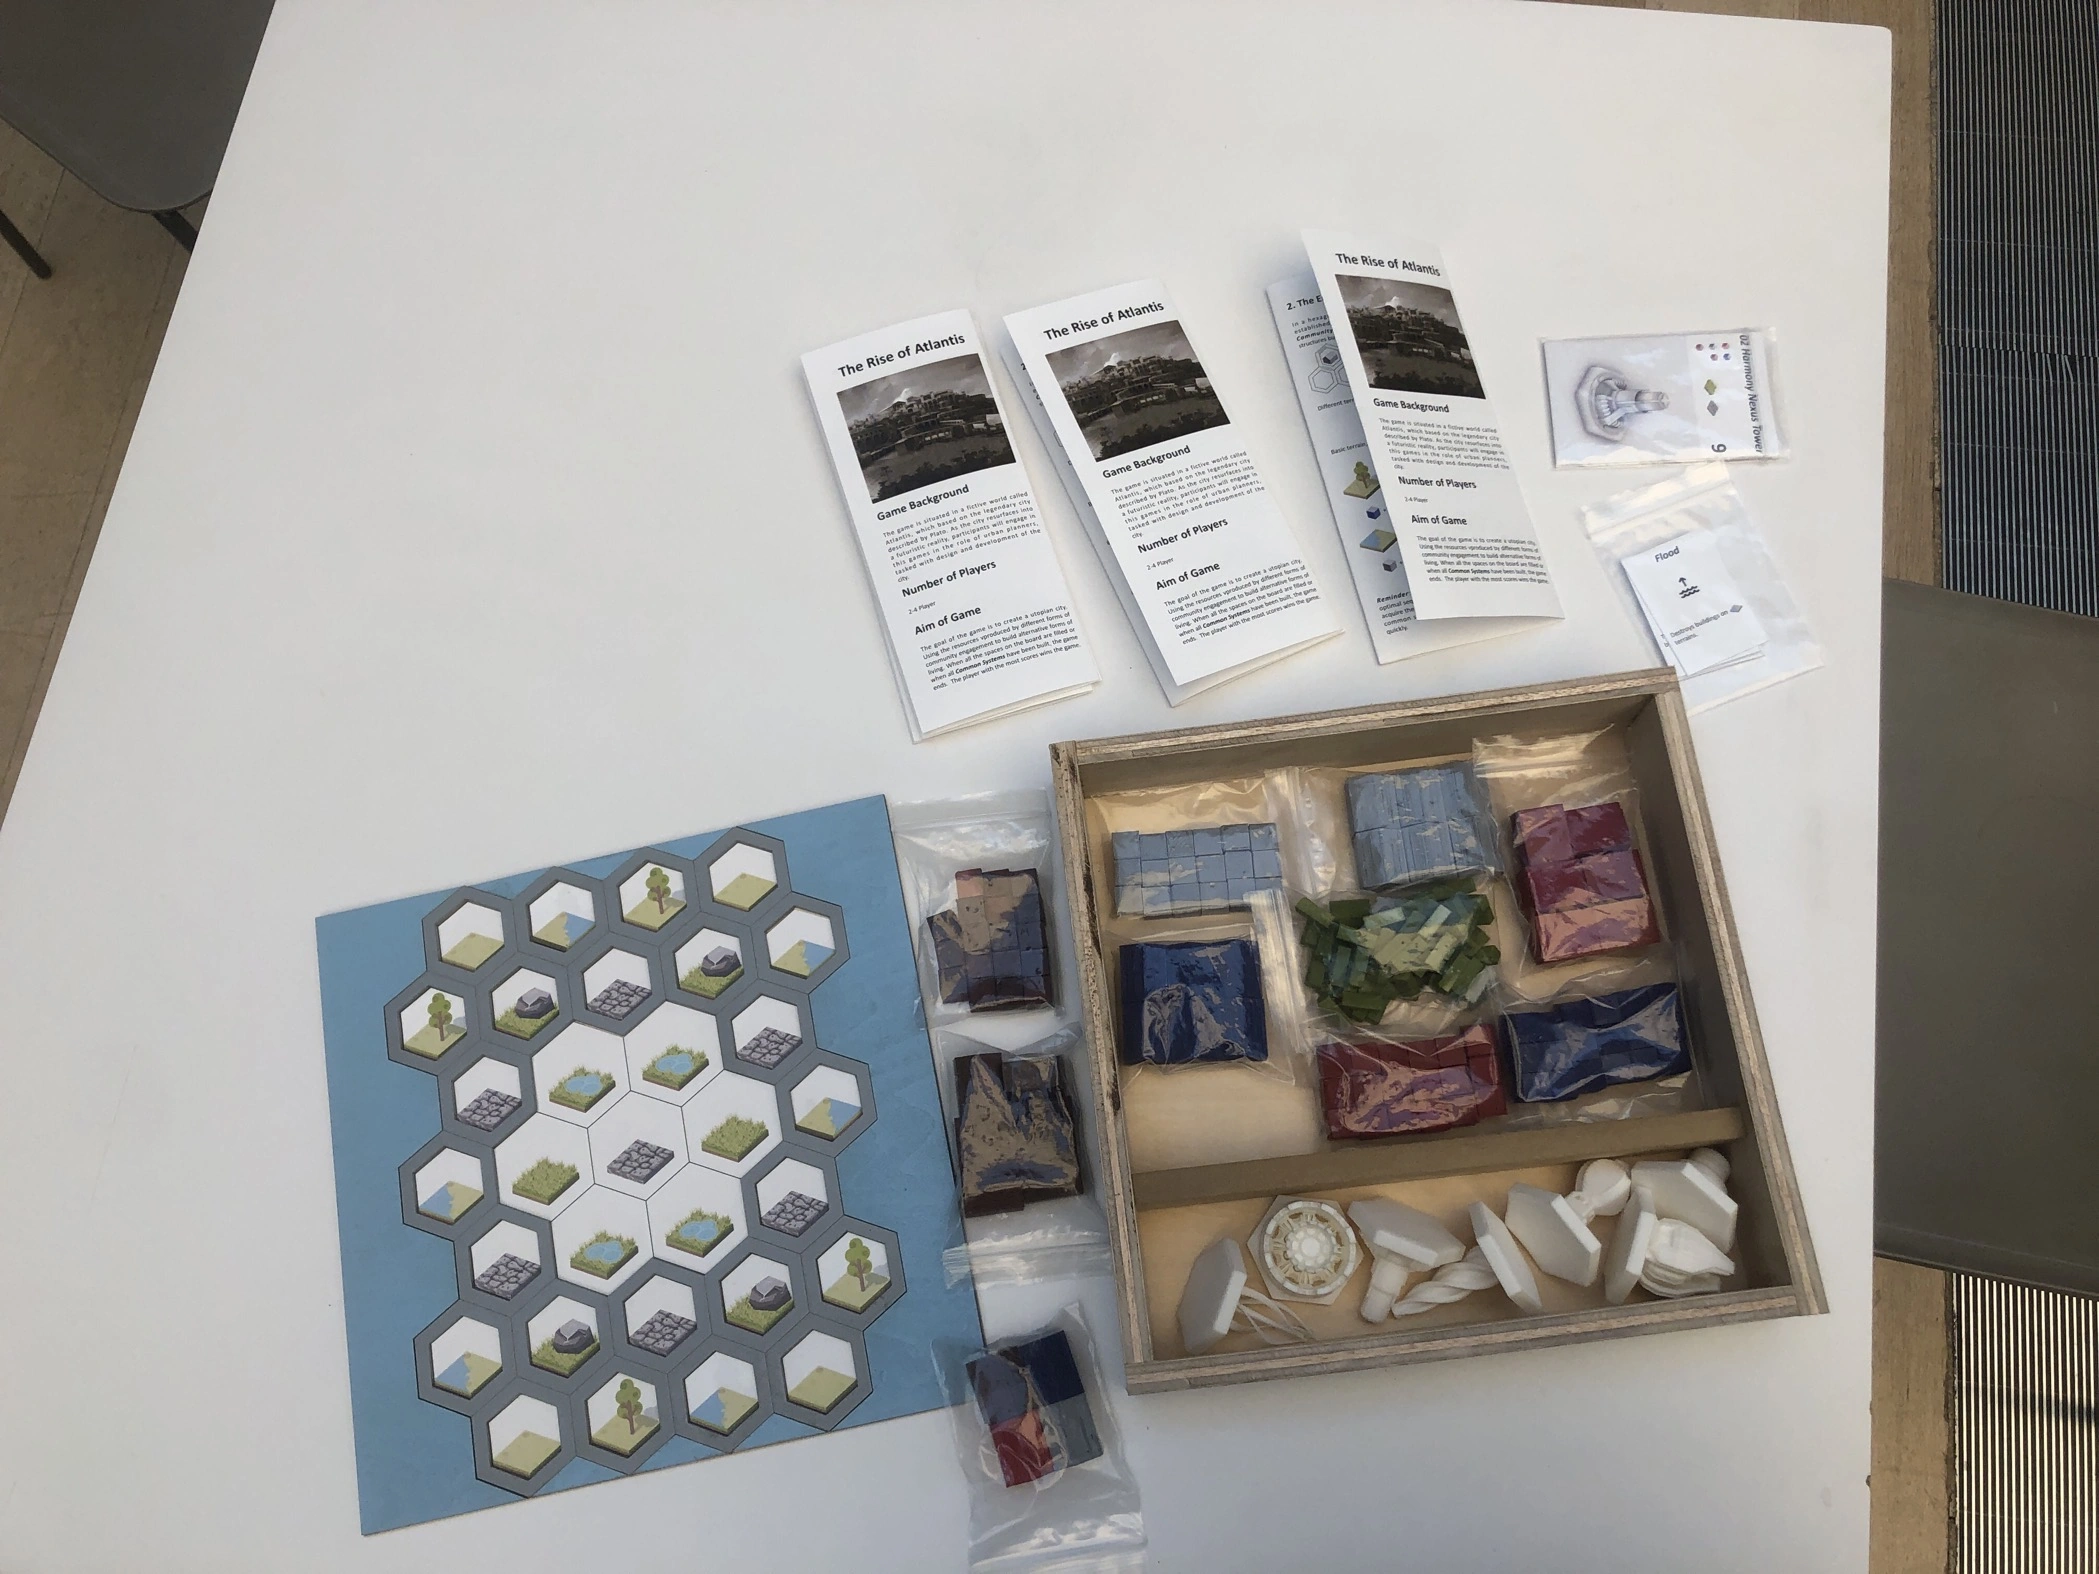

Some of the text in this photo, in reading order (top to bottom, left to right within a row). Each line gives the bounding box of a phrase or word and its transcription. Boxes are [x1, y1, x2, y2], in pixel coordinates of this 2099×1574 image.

[1335, 253, 1441, 277] The Rise of Atlantis
[1286, 302, 1296, 310] 2.
[1296, 298, 1315, 307] The
[1043, 301, 1164, 340] The Rise of Atlantis
[1294, 321, 1331, 334] established
[1296, 328, 1333, 341] Community
[837, 334, 965, 377] The Rise of Atlantis
[1298, 338, 1327, 348] structures
[1317, 400, 1342, 411] Different
[1373, 398, 1450, 413] Game Background
[1739, 333, 1763, 453] 02 Harmony Nexus Tower
[1102, 445, 1191, 478] Game Background
[1331, 447, 1346, 455] Basic
[1398, 476, 1477, 490] Number of Players
[877, 484, 969, 521] Game Background
[882, 530, 895, 538] The
[896, 524, 914, 534] game
[923, 511, 950, 524] situated
[966, 501, 987, 511] fictive
[989, 495, 1008, 504] world
[1009, 491, 1028, 500] called
[885, 533, 914, 546] Atlantis,
[915, 524, 935, 535] which
[936, 517, 957, 528] based
[983, 502, 1016, 514] legendary
[887, 538, 919, 553] described
[986, 509, 1019, 521] resurfaces
[1411, 514, 1468, 525] Aim of Game
[892, 560, 907, 568] this
[908, 551, 930, 563] games
[942, 543, 954, 551] the
[956, 538, 971, 546] role
[983, 529, 1004, 538] urban
[1006, 522, 1039, 533] planners,
[896, 544, 926, 558] futuristic
[927, 537, 950, 547] reality,
[951, 525, 990, 540] participants
[991, 520, 1004, 528] will
[1005, 516, 1027, 524] engage
[1137, 519, 1228, 553] Number of Players
[895, 563, 917, 575] tasked
[919, 558, 934, 566] with
[936, 550, 958, 561] design
[960, 545, 973, 553] and
[975, 533, 1019, 549] development
[1654, 545, 1680, 563] Flood
[902, 561, 996, 597] Number of Players
[1156, 563, 1220, 590] Aim of Game
[1167, 605, 1185, 615] Using
[1195, 592, 1223, 605] resources
[1222, 581, 1252, 596] vproduced
[1260, 571, 1284, 583] different
[1283, 567, 1300, 575] forms
[1177, 594, 1190, 604] goal
[1211, 582, 1227, 592] game
[1243, 570, 1261, 580] create
[1268, 562, 1290, 572] utopian
[1171, 608, 1203, 622] community
[1203, 595, 1237, 611] engagement
[1244, 587, 1259, 597] build
[1259, 579, 1288, 592] alternative
[1287, 574, 1304, 582] forms
[1379, 601, 1402, 611] optimal
[915, 607, 981, 635] Aim of Game
[1382, 609, 1404, 618] acquire
[1383, 616, 1411, 626] common
[1694, 614, 1720, 628] buildings
[930, 674, 947, 683] when
[955, 662, 982, 674] Common
[982, 654, 1006, 666] Systems
[1006, 650, 1020, 658] have
[1020, 645, 1036, 654] been
[1062, 635, 1078, 644] game
